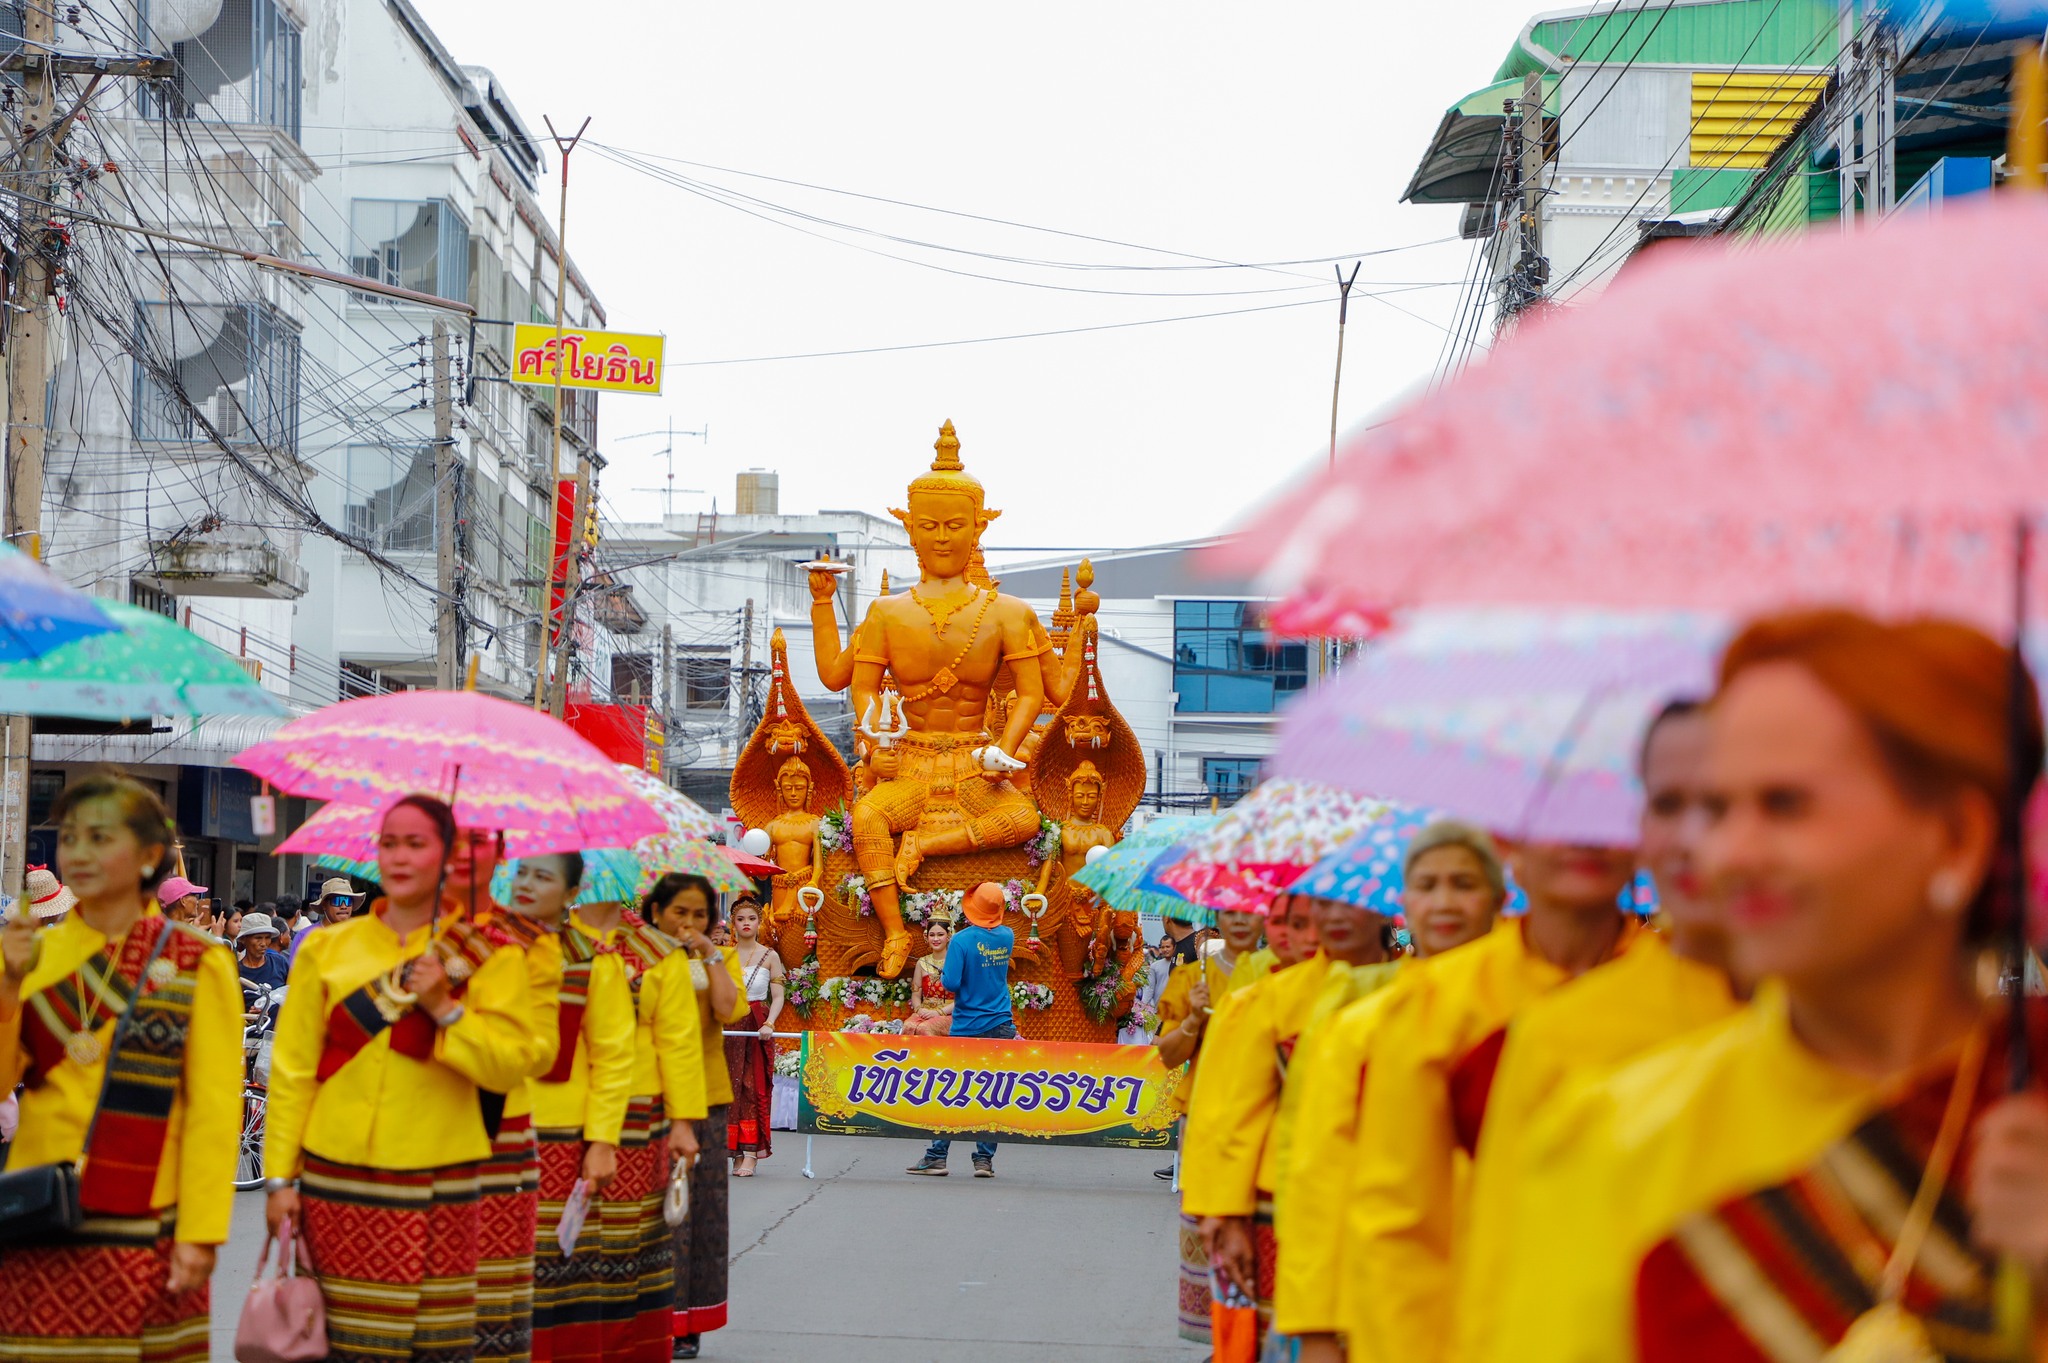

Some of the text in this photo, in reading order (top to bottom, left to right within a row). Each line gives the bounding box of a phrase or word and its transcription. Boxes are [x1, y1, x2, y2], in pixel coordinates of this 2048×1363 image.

[519, 336, 655, 385] ศรีโยธิน
[847, 1049, 1145, 1115] เทียนพรรษา
